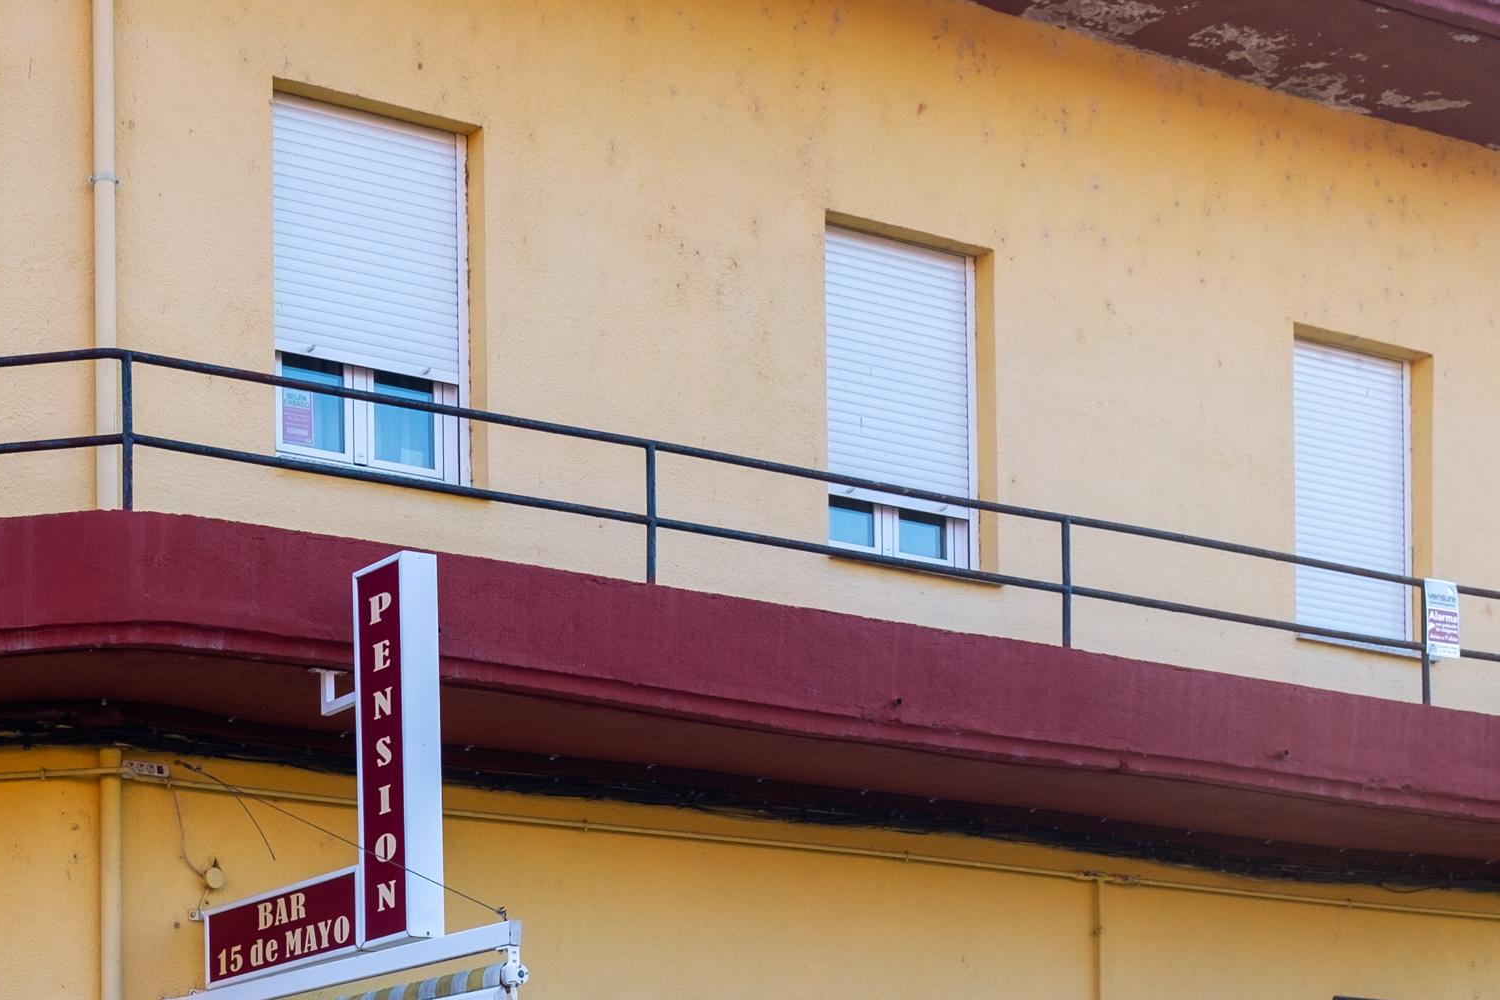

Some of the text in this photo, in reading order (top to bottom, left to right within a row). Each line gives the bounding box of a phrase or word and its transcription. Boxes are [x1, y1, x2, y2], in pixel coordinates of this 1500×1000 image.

[369, 592, 397, 912] PENSION
[257, 892, 307, 931] BAR
[218, 915, 350, 976] 15 de MAYO
